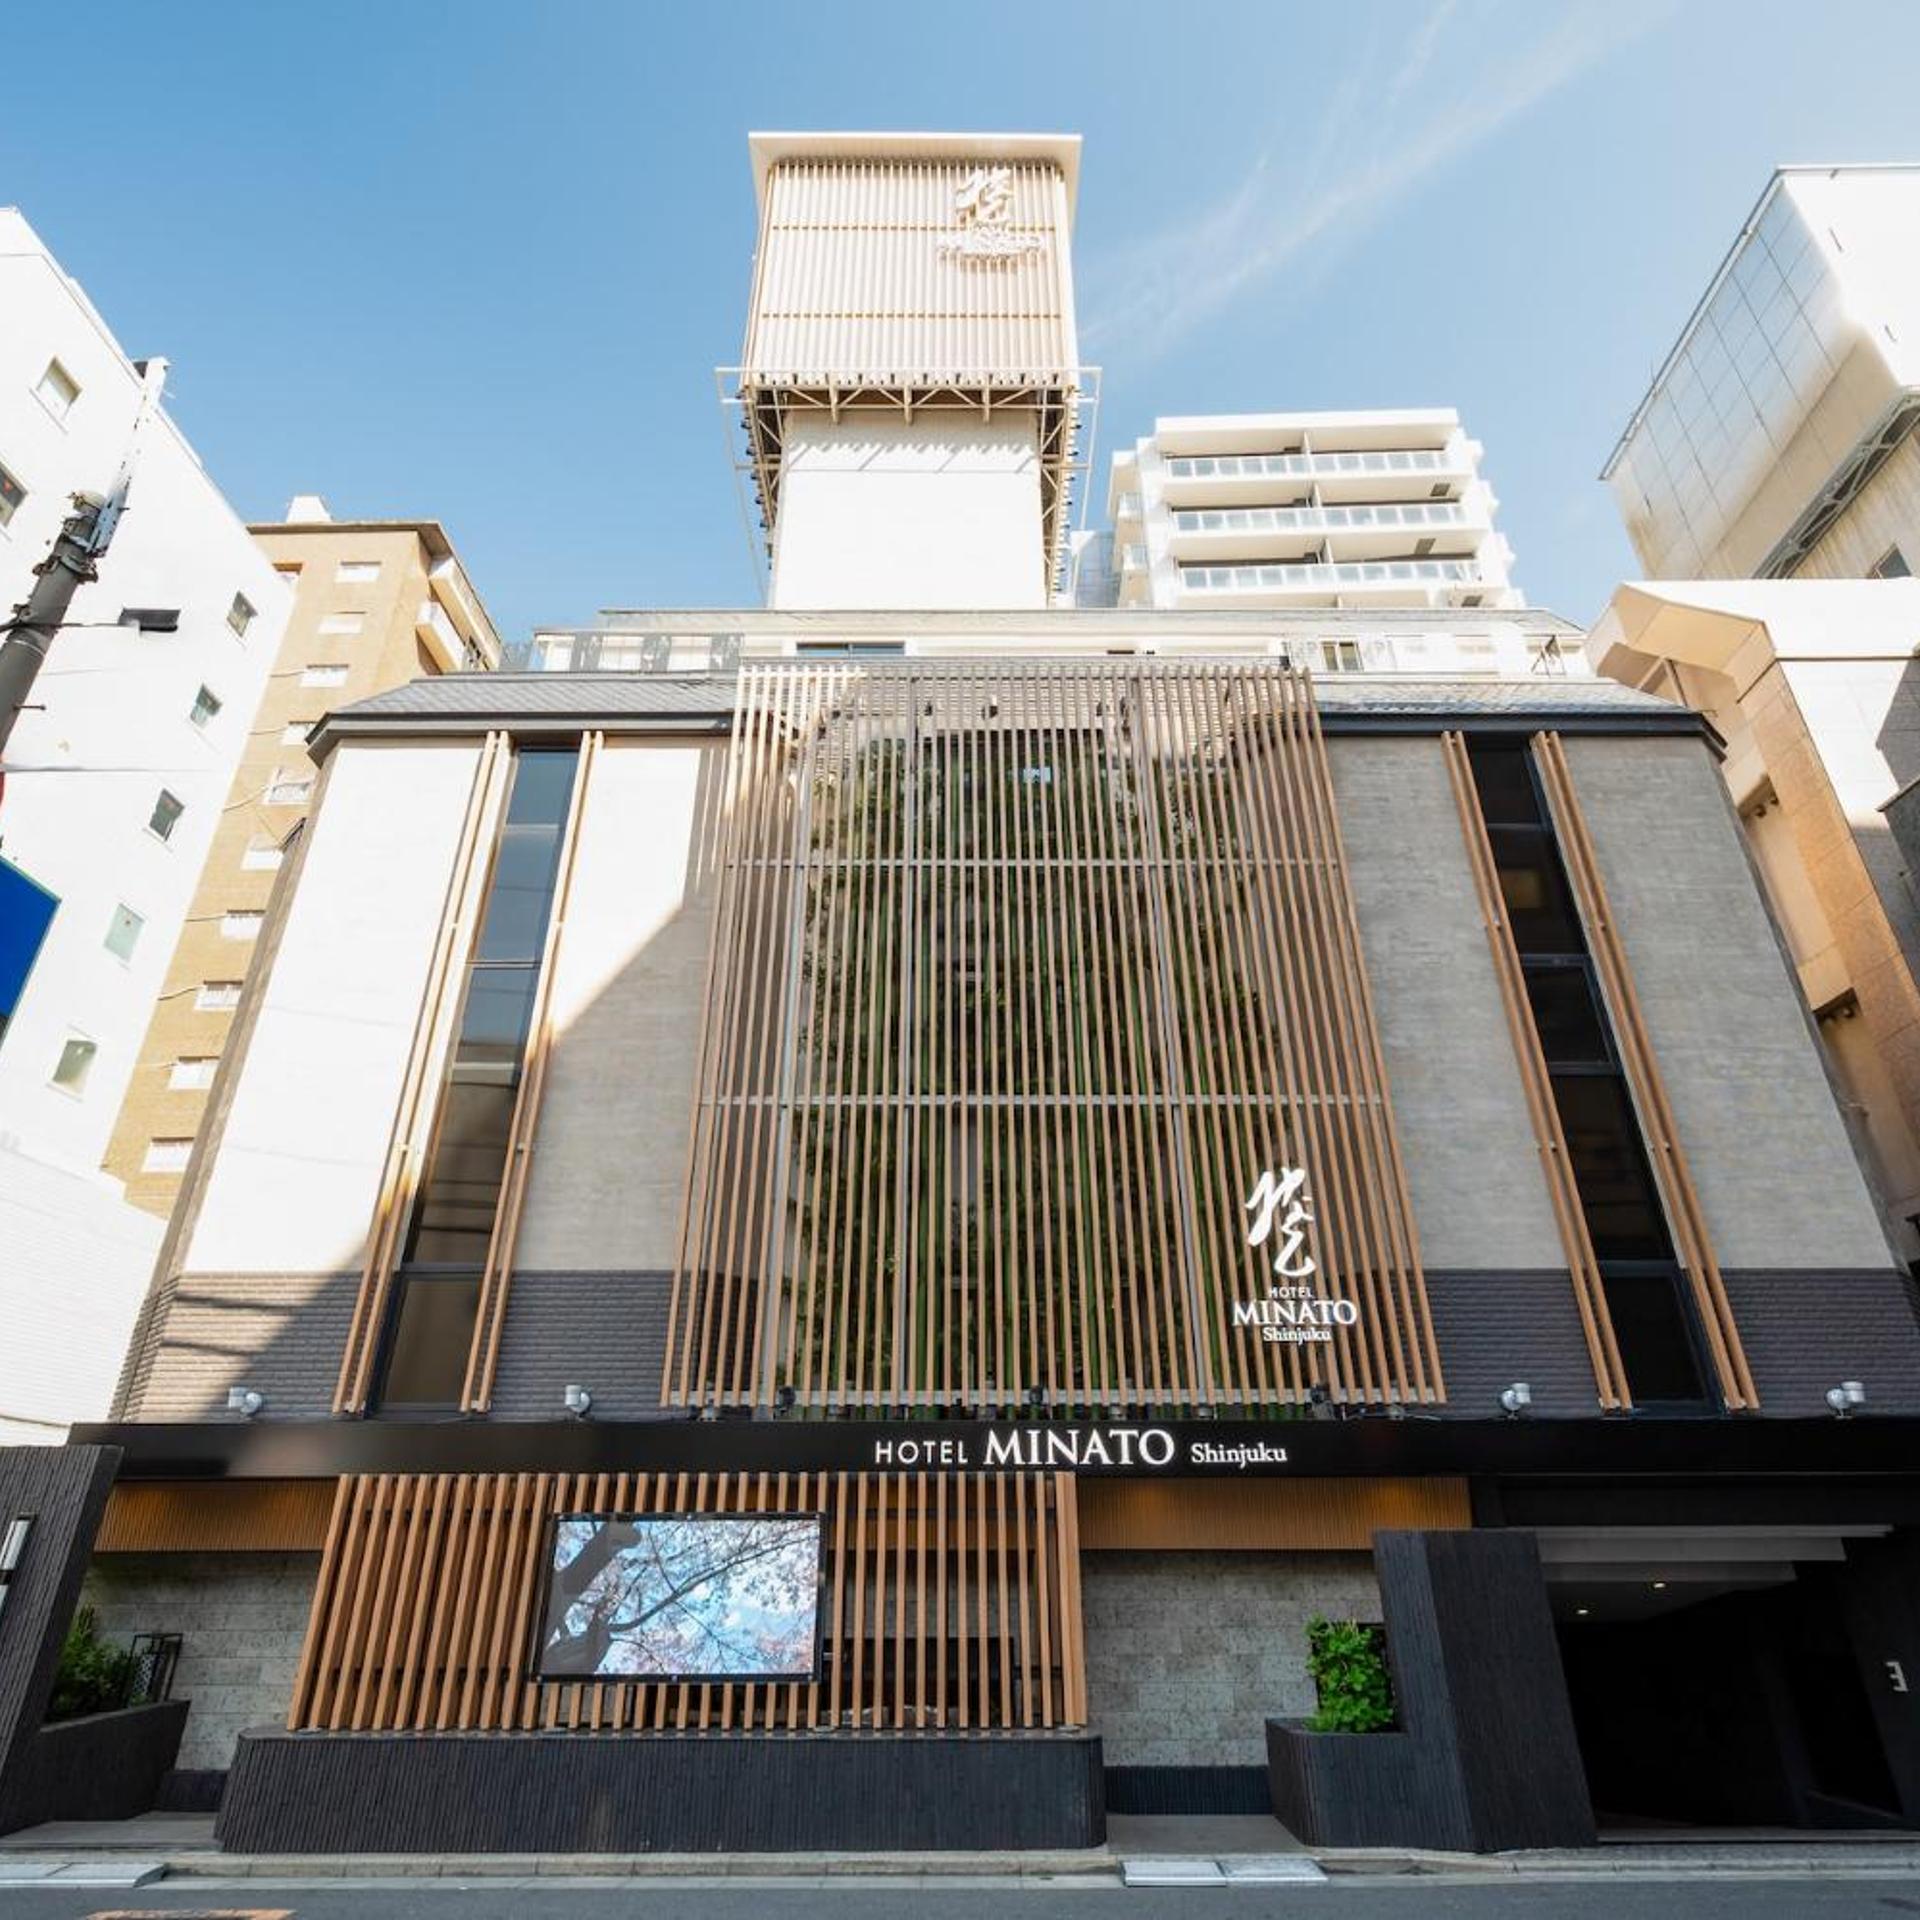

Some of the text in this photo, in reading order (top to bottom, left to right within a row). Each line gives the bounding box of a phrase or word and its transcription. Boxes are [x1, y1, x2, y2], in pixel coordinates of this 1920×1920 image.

[1268, 1286, 1315, 1299] HOTEL
[1232, 1300, 1358, 1326] MINATO
[1262, 1326, 1332, 1346] Shinjuku
[874, 1428, 1289, 1469] HOTEL MINATO Shinjuku
